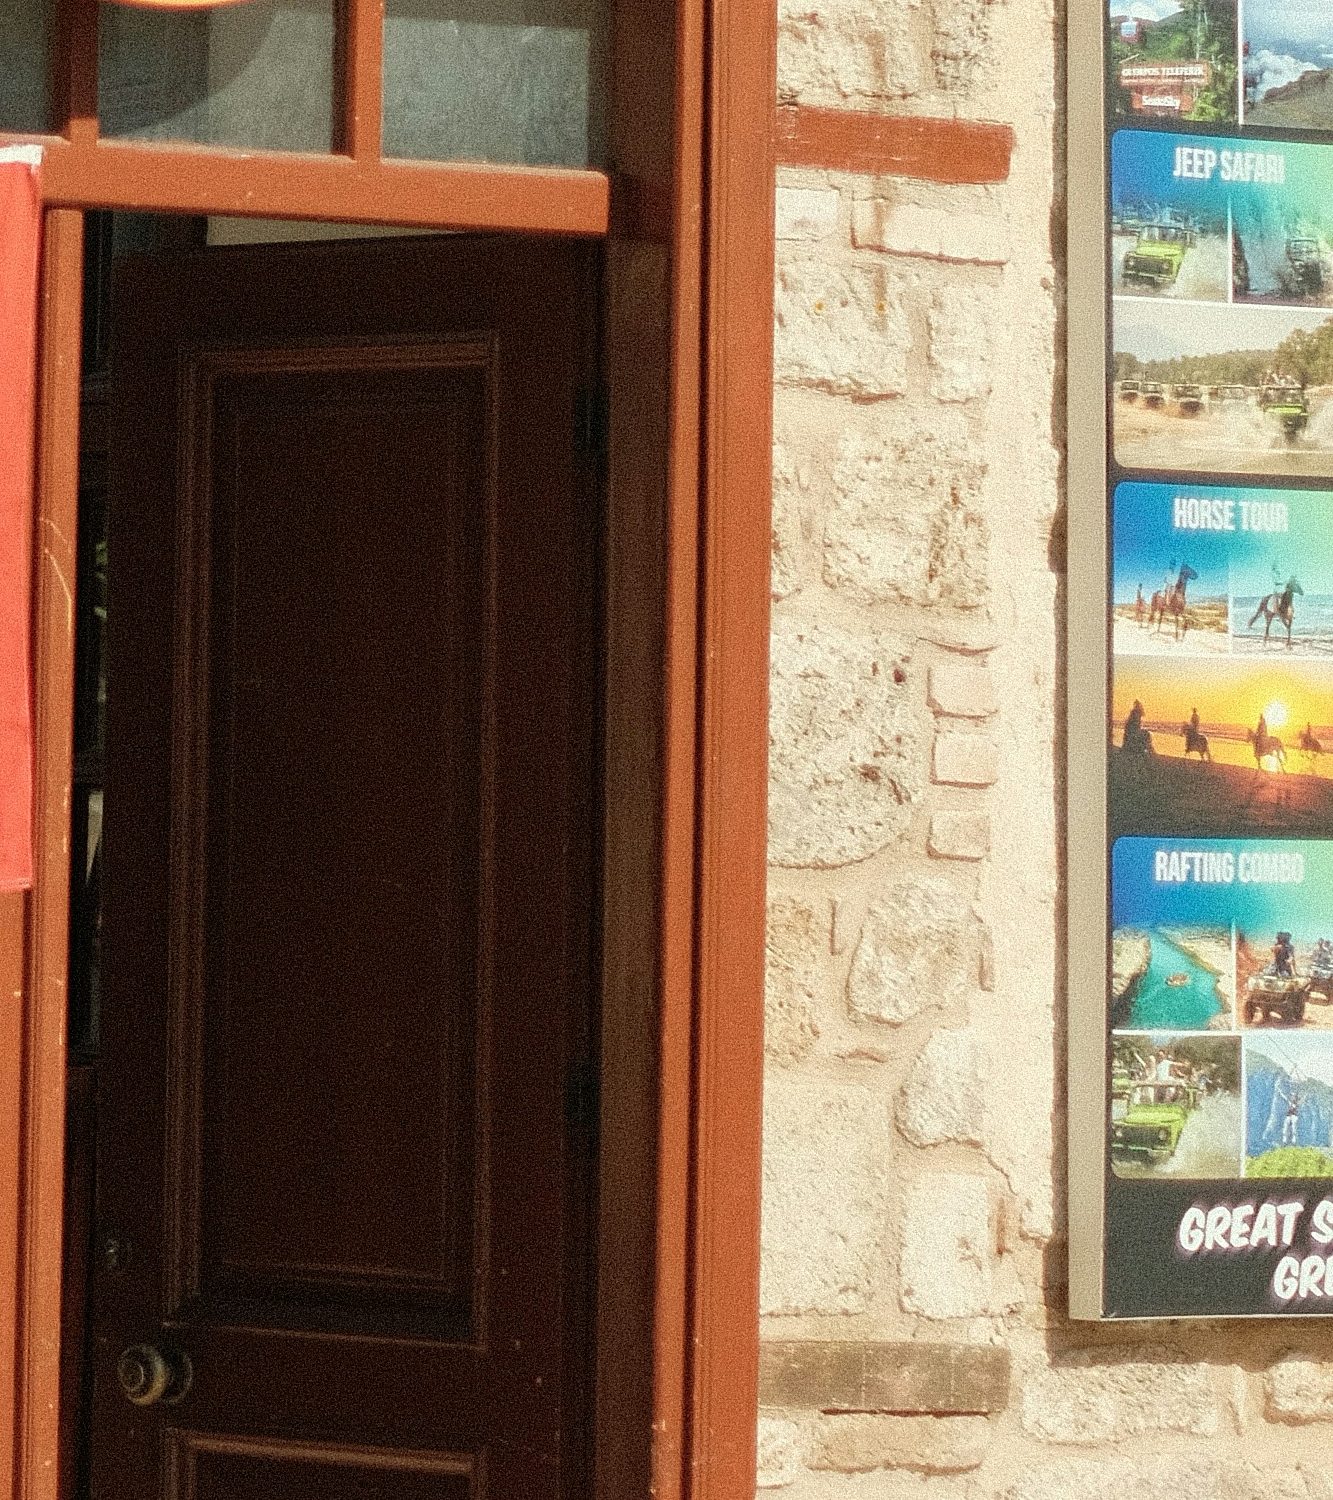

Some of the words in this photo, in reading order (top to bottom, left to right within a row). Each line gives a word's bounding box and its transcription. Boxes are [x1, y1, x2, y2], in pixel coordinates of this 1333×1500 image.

[1173, 146, 1217, 179] JEEP
[1220, 150, 1285, 183] SAFARI
[1174, 498, 1235, 530] HORSE
[1238, 501, 1289, 532] TOUR
[1155, 850, 1233, 882] RAFTING
[1238, 852, 1305, 883] COMBO
[1179, 1202, 1304, 1251] GREAT
